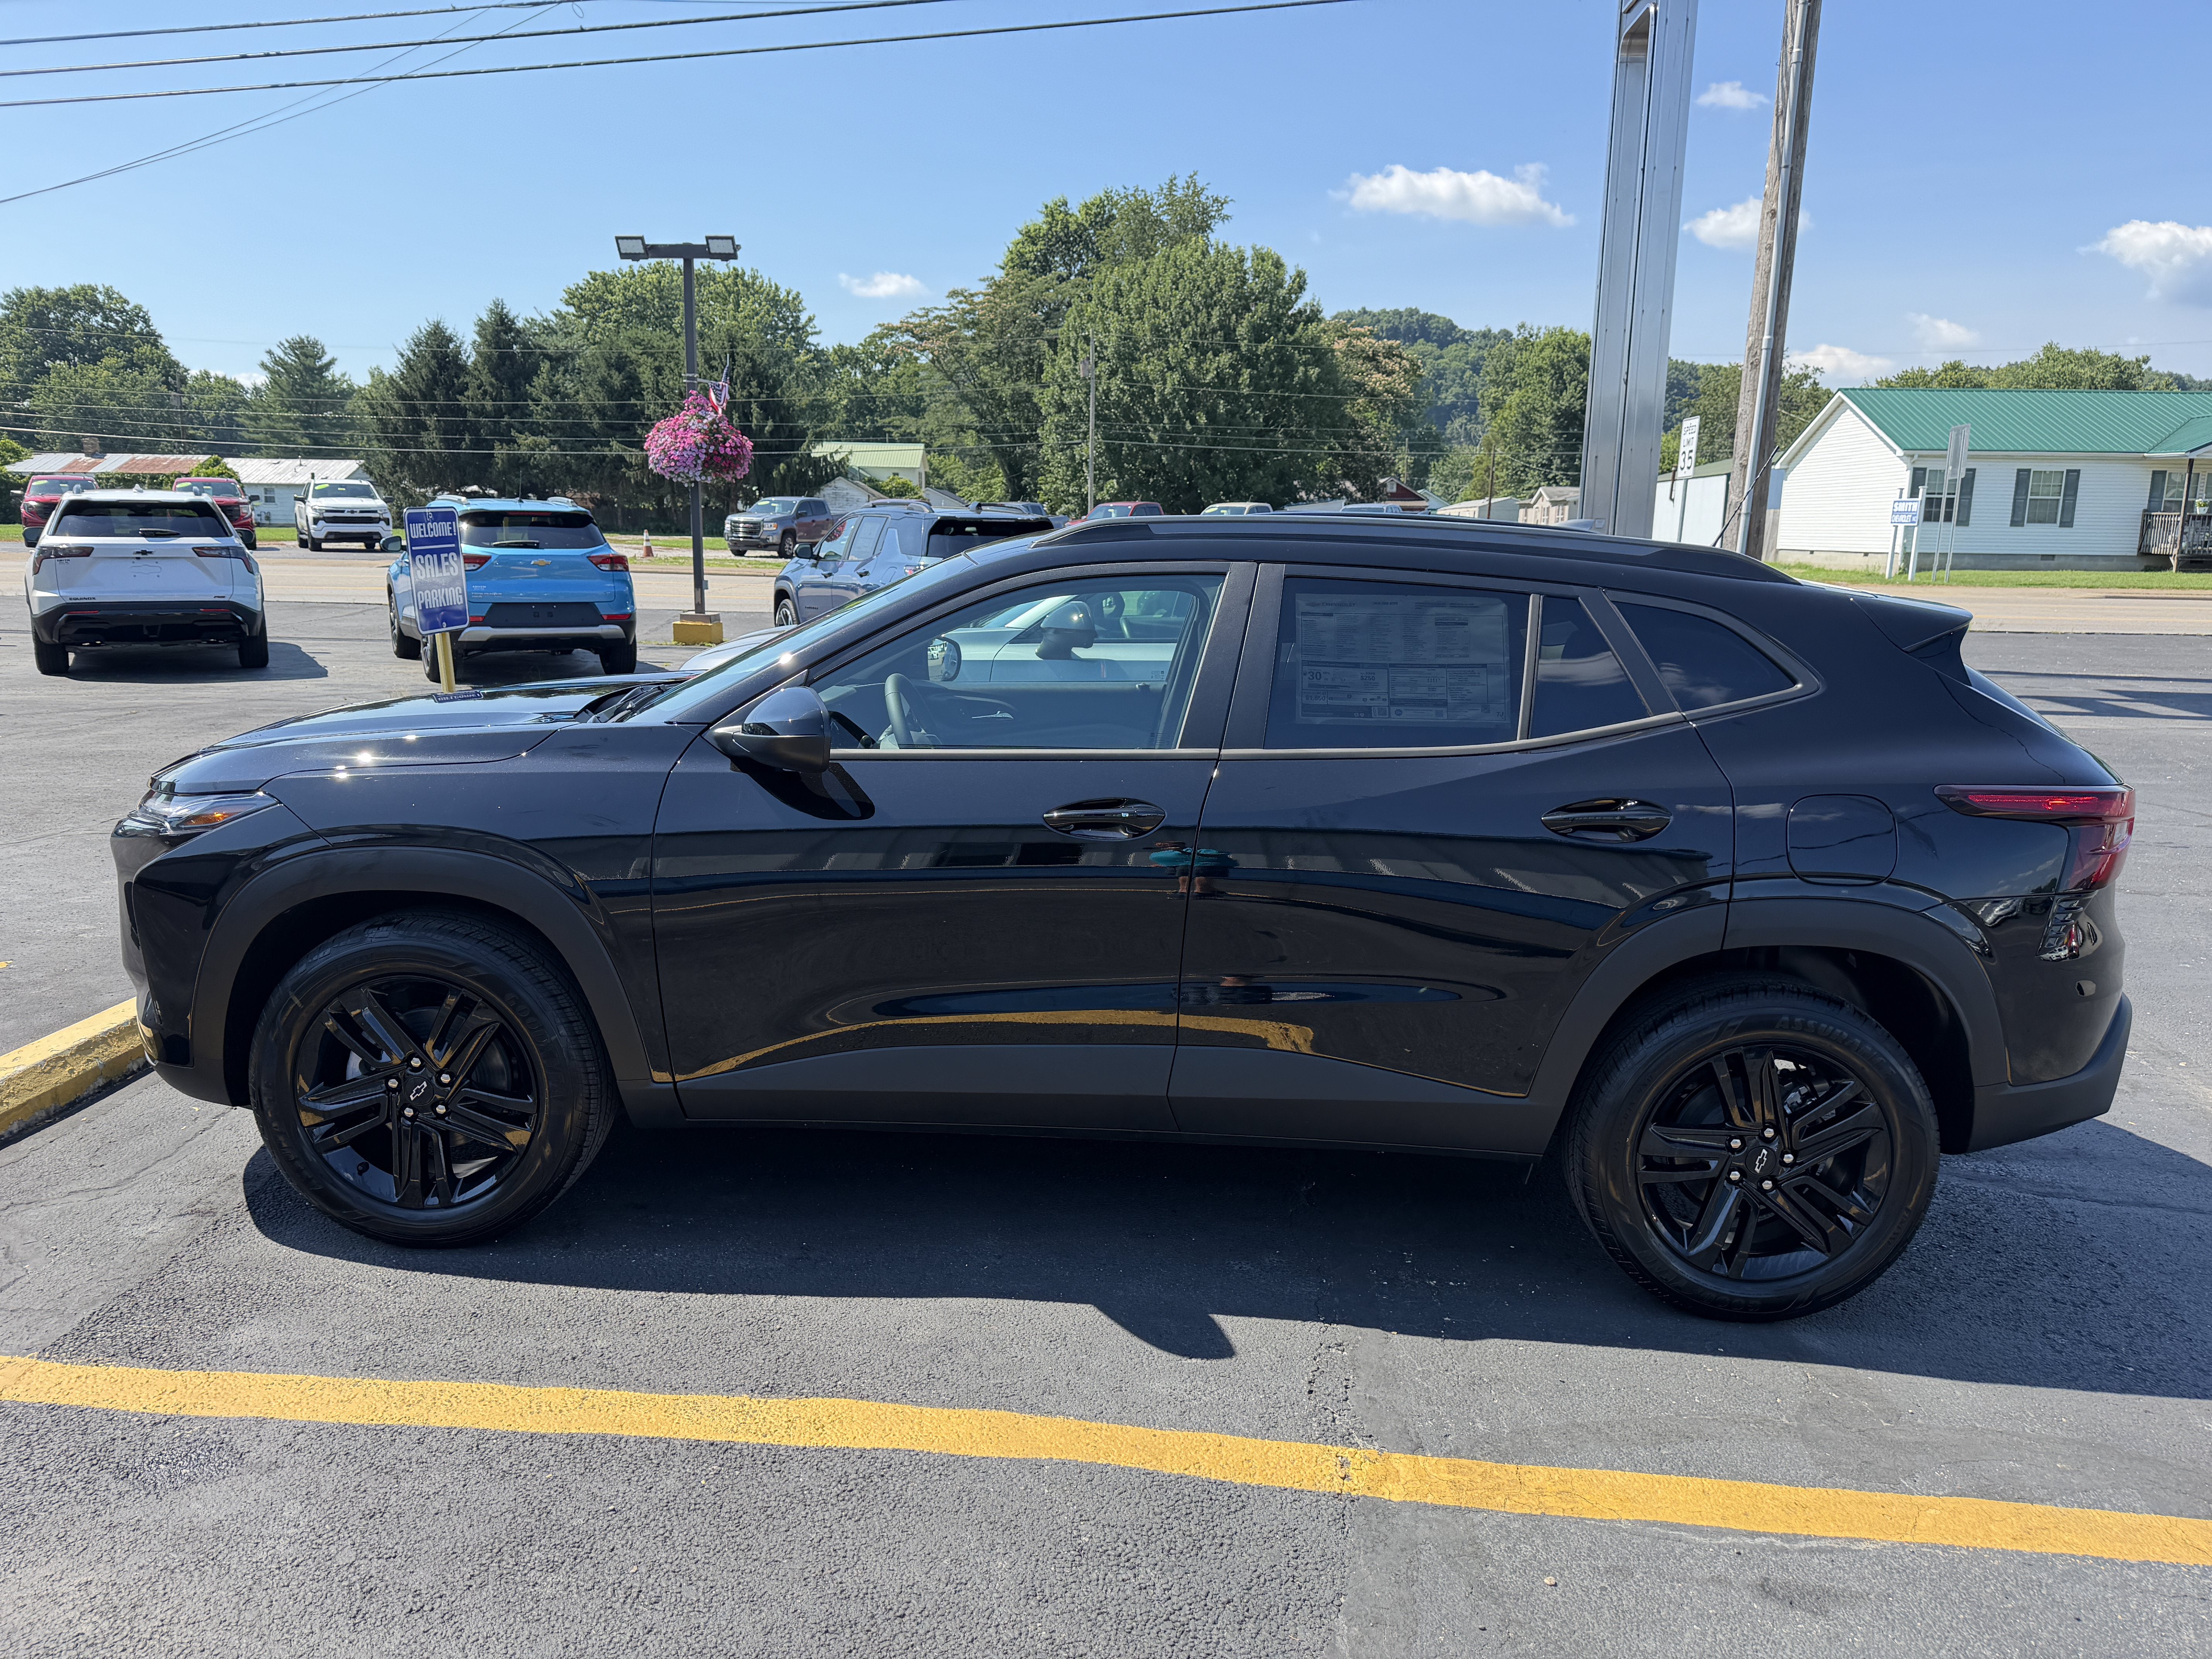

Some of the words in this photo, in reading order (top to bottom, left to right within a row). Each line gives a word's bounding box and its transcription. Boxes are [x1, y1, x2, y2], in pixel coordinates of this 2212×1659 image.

[1683, 424, 1696, 435] SPEED
[1683, 437, 1694, 447] LIMIT
[1680, 449, 1693, 471] 35
[1893, 502, 1918, 512] SMITH
[410, 522, 457, 538] WELCOME!
[416, 552, 459, 579] SALES
[417, 586, 463, 610] PARKING
[1308, 671, 1322, 680] 30
[1775, 1015, 1896, 1080] ASSURANCE
